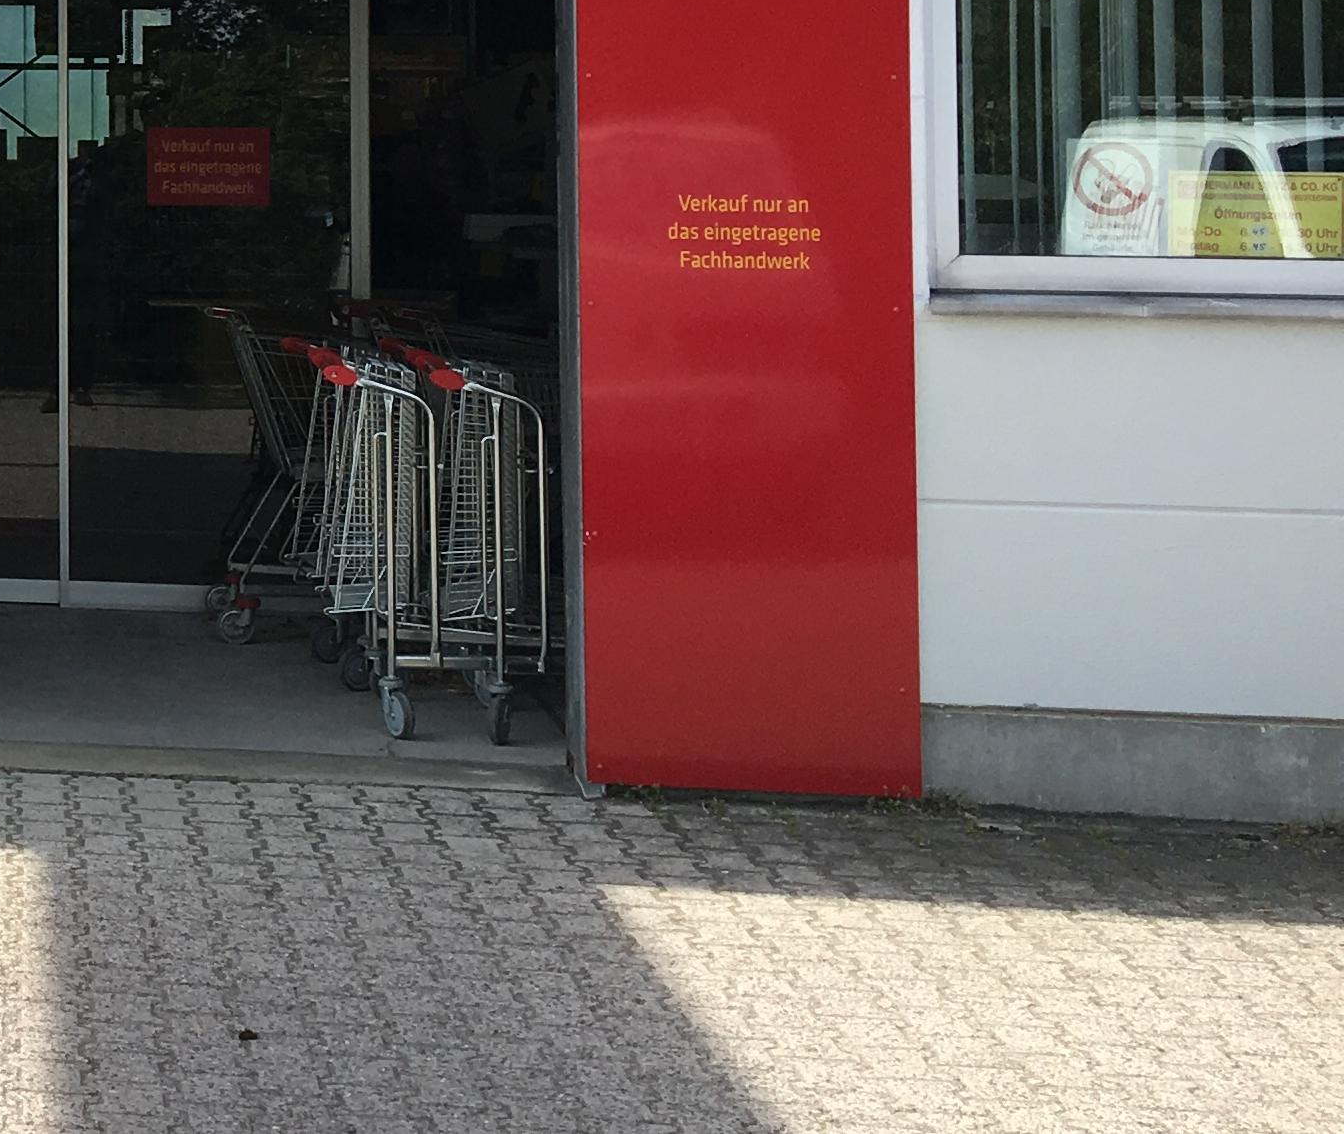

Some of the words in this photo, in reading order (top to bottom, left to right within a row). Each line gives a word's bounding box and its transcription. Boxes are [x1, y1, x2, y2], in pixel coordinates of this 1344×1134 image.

[161, 139, 211, 152] Verkauf
[215, 143, 234, 153] nur
[238, 143, 255, 153] an
[154, 159, 176, 172] das
[180, 159, 263, 177] eingetragene
[162, 181, 255, 194] Fachhandwerk
[1300, 181, 1319, 191] CO.
[1322, 182, 1338, 192] KG
[679, 194, 748, 212] Verkauf
[753, 197, 782, 212] nur
[788, 198, 809, 213] an
[1214, 206, 1303, 222] Öffnungszn
[668, 222, 699, 240] das
[704, 222, 821, 245] eingetragene
[1316, 228, 1339, 239] Uhr
[1316, 243, 1339, 253] Uhr
[680, 251, 810, 270] Fachhandwerk
